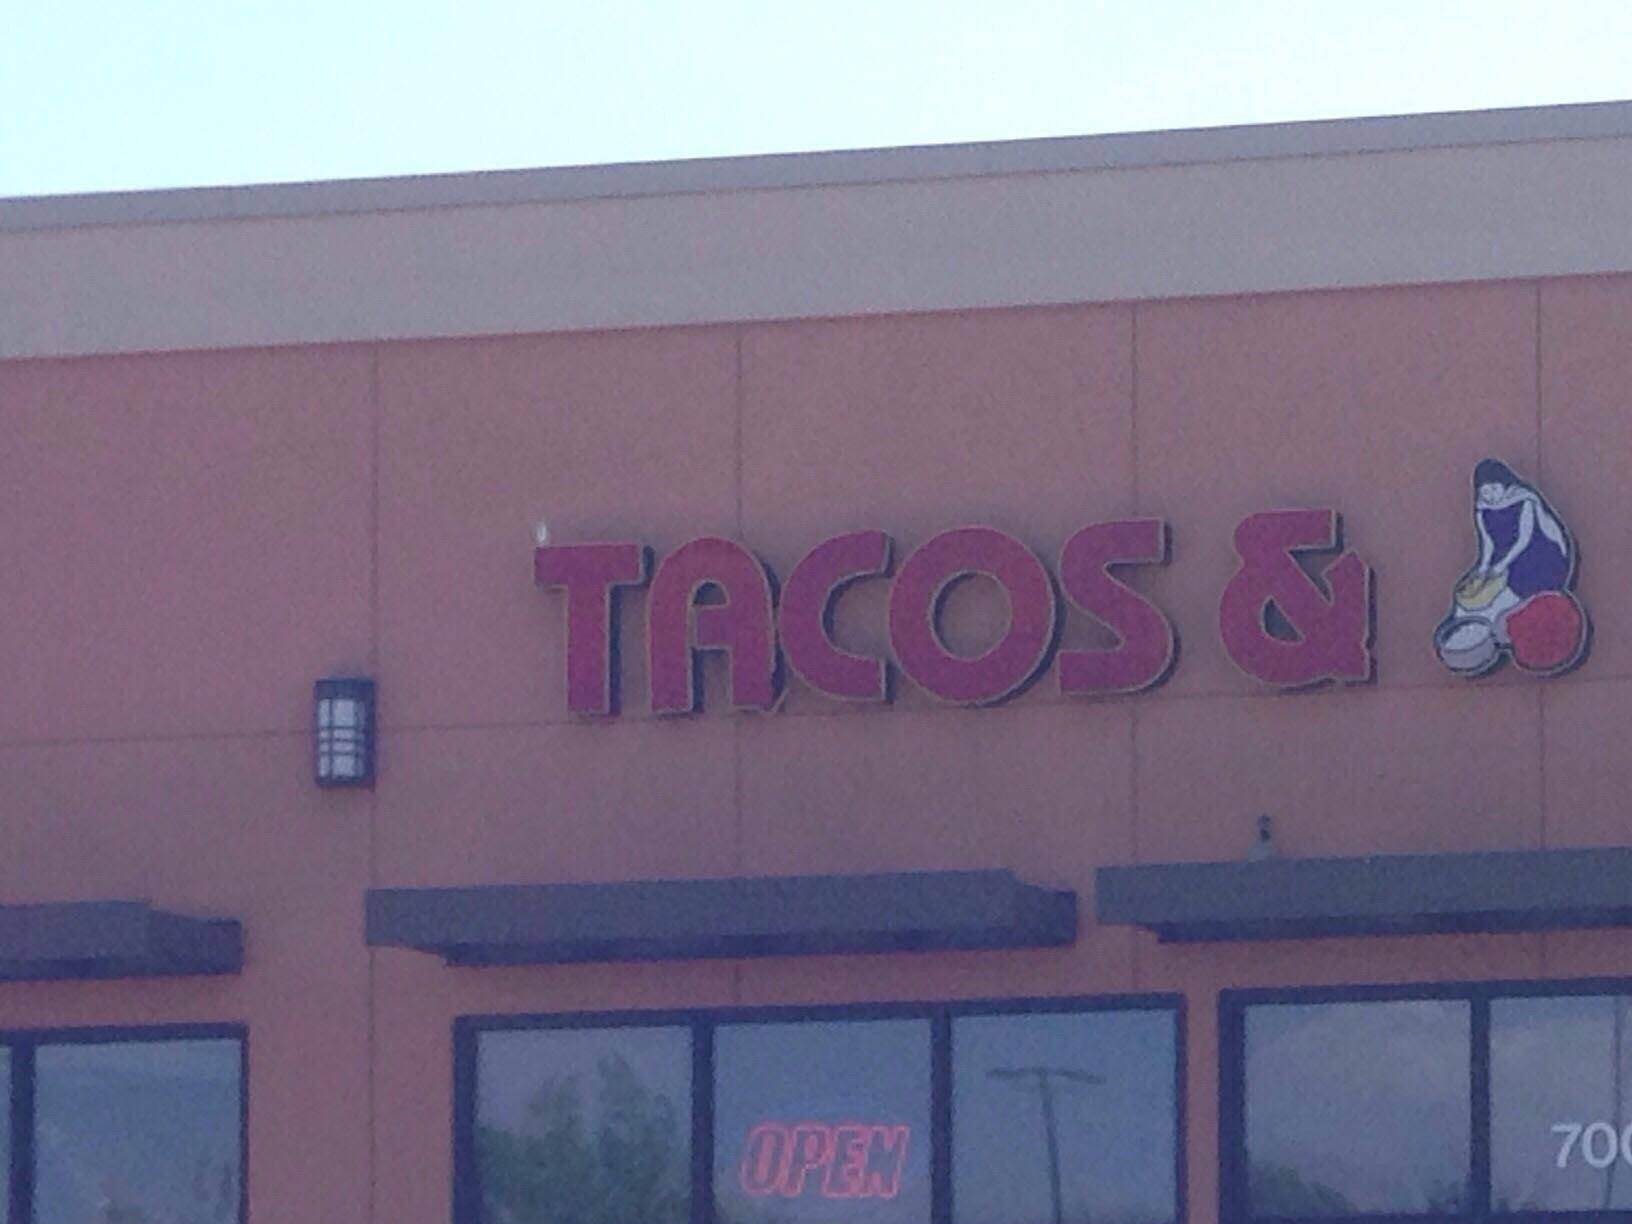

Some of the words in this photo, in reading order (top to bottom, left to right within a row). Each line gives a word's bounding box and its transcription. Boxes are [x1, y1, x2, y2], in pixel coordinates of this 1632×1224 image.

[534, 516, 1176, 716] TACOS
[1219, 508, 1378, 688] &
[740, 1119, 910, 1200] OPEN
